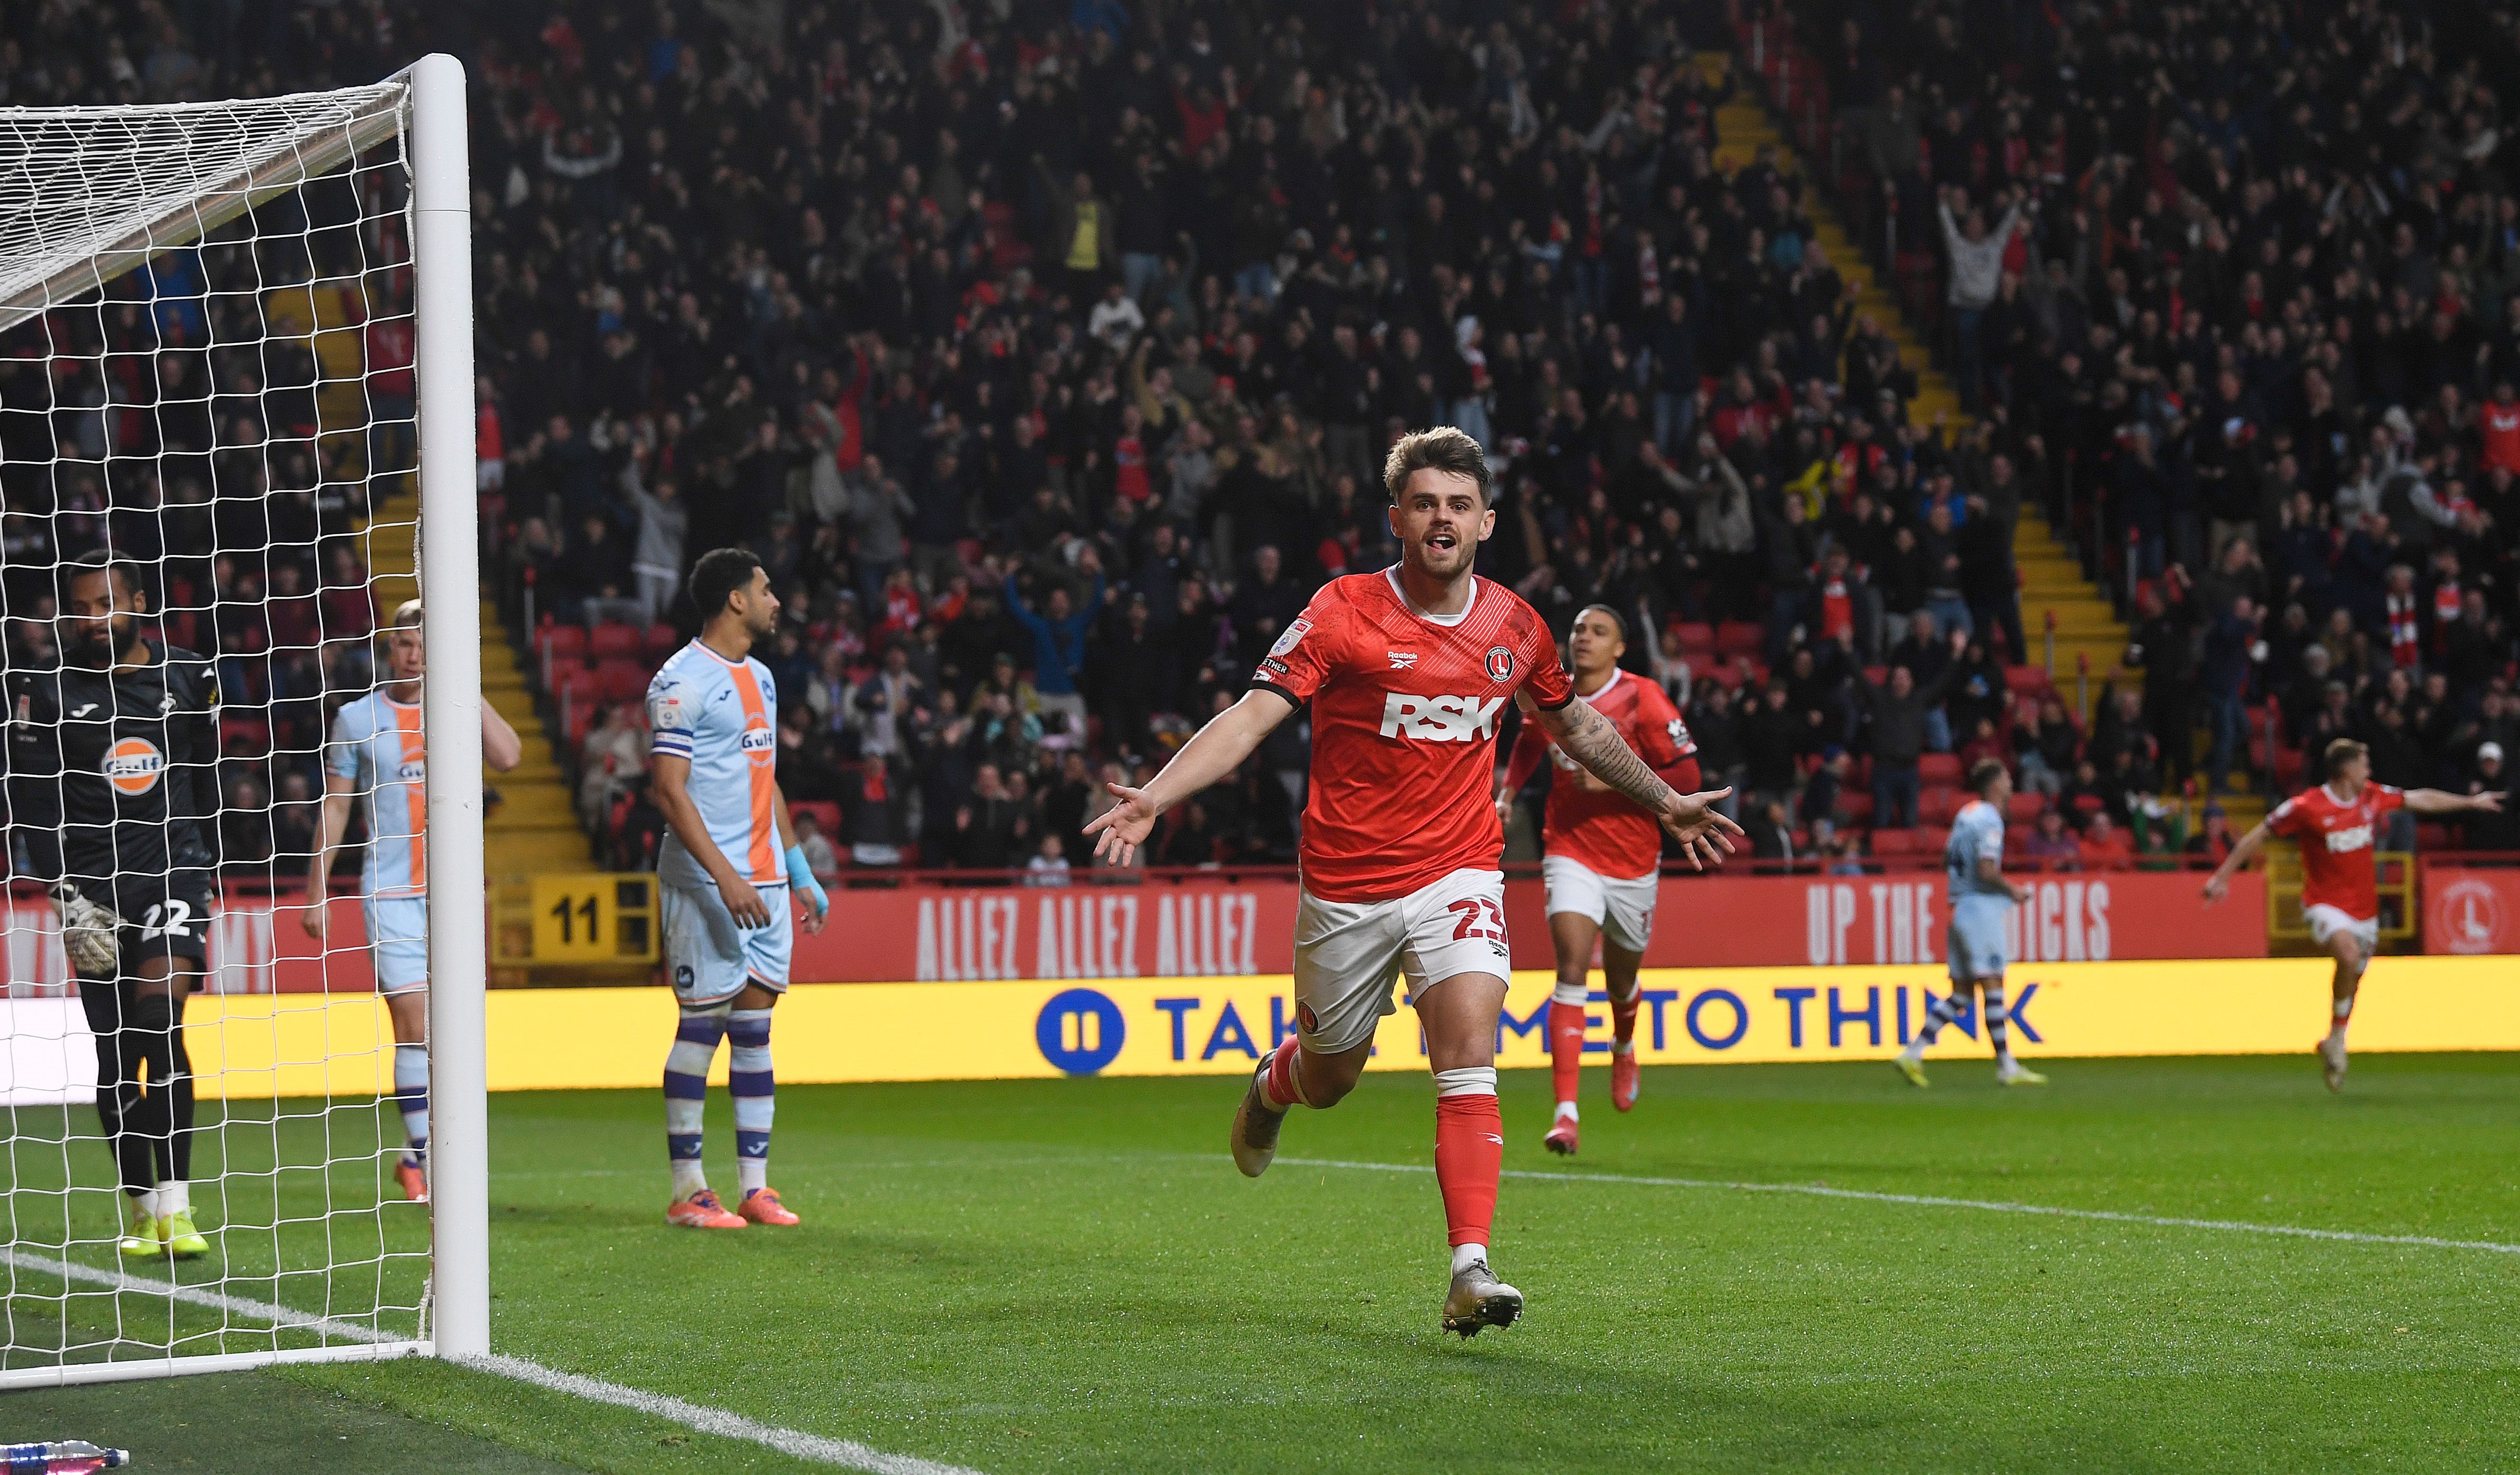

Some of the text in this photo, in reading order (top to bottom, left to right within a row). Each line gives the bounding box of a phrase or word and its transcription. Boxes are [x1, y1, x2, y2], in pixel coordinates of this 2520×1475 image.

[1379, 692, 1506, 742] RSK
[141, 899, 191, 943] 22
[551, 895, 597, 942] 11
[916, 893, 1258, 981] ALLEZ ALLEZ ALLEZ
[1447, 898, 1507, 945] 23
[1806, 881, 2110, 965] UP THE DICKS
[1154, 997, 1377, 1061] TAK
[1640, 989, 1748, 1051] TO
